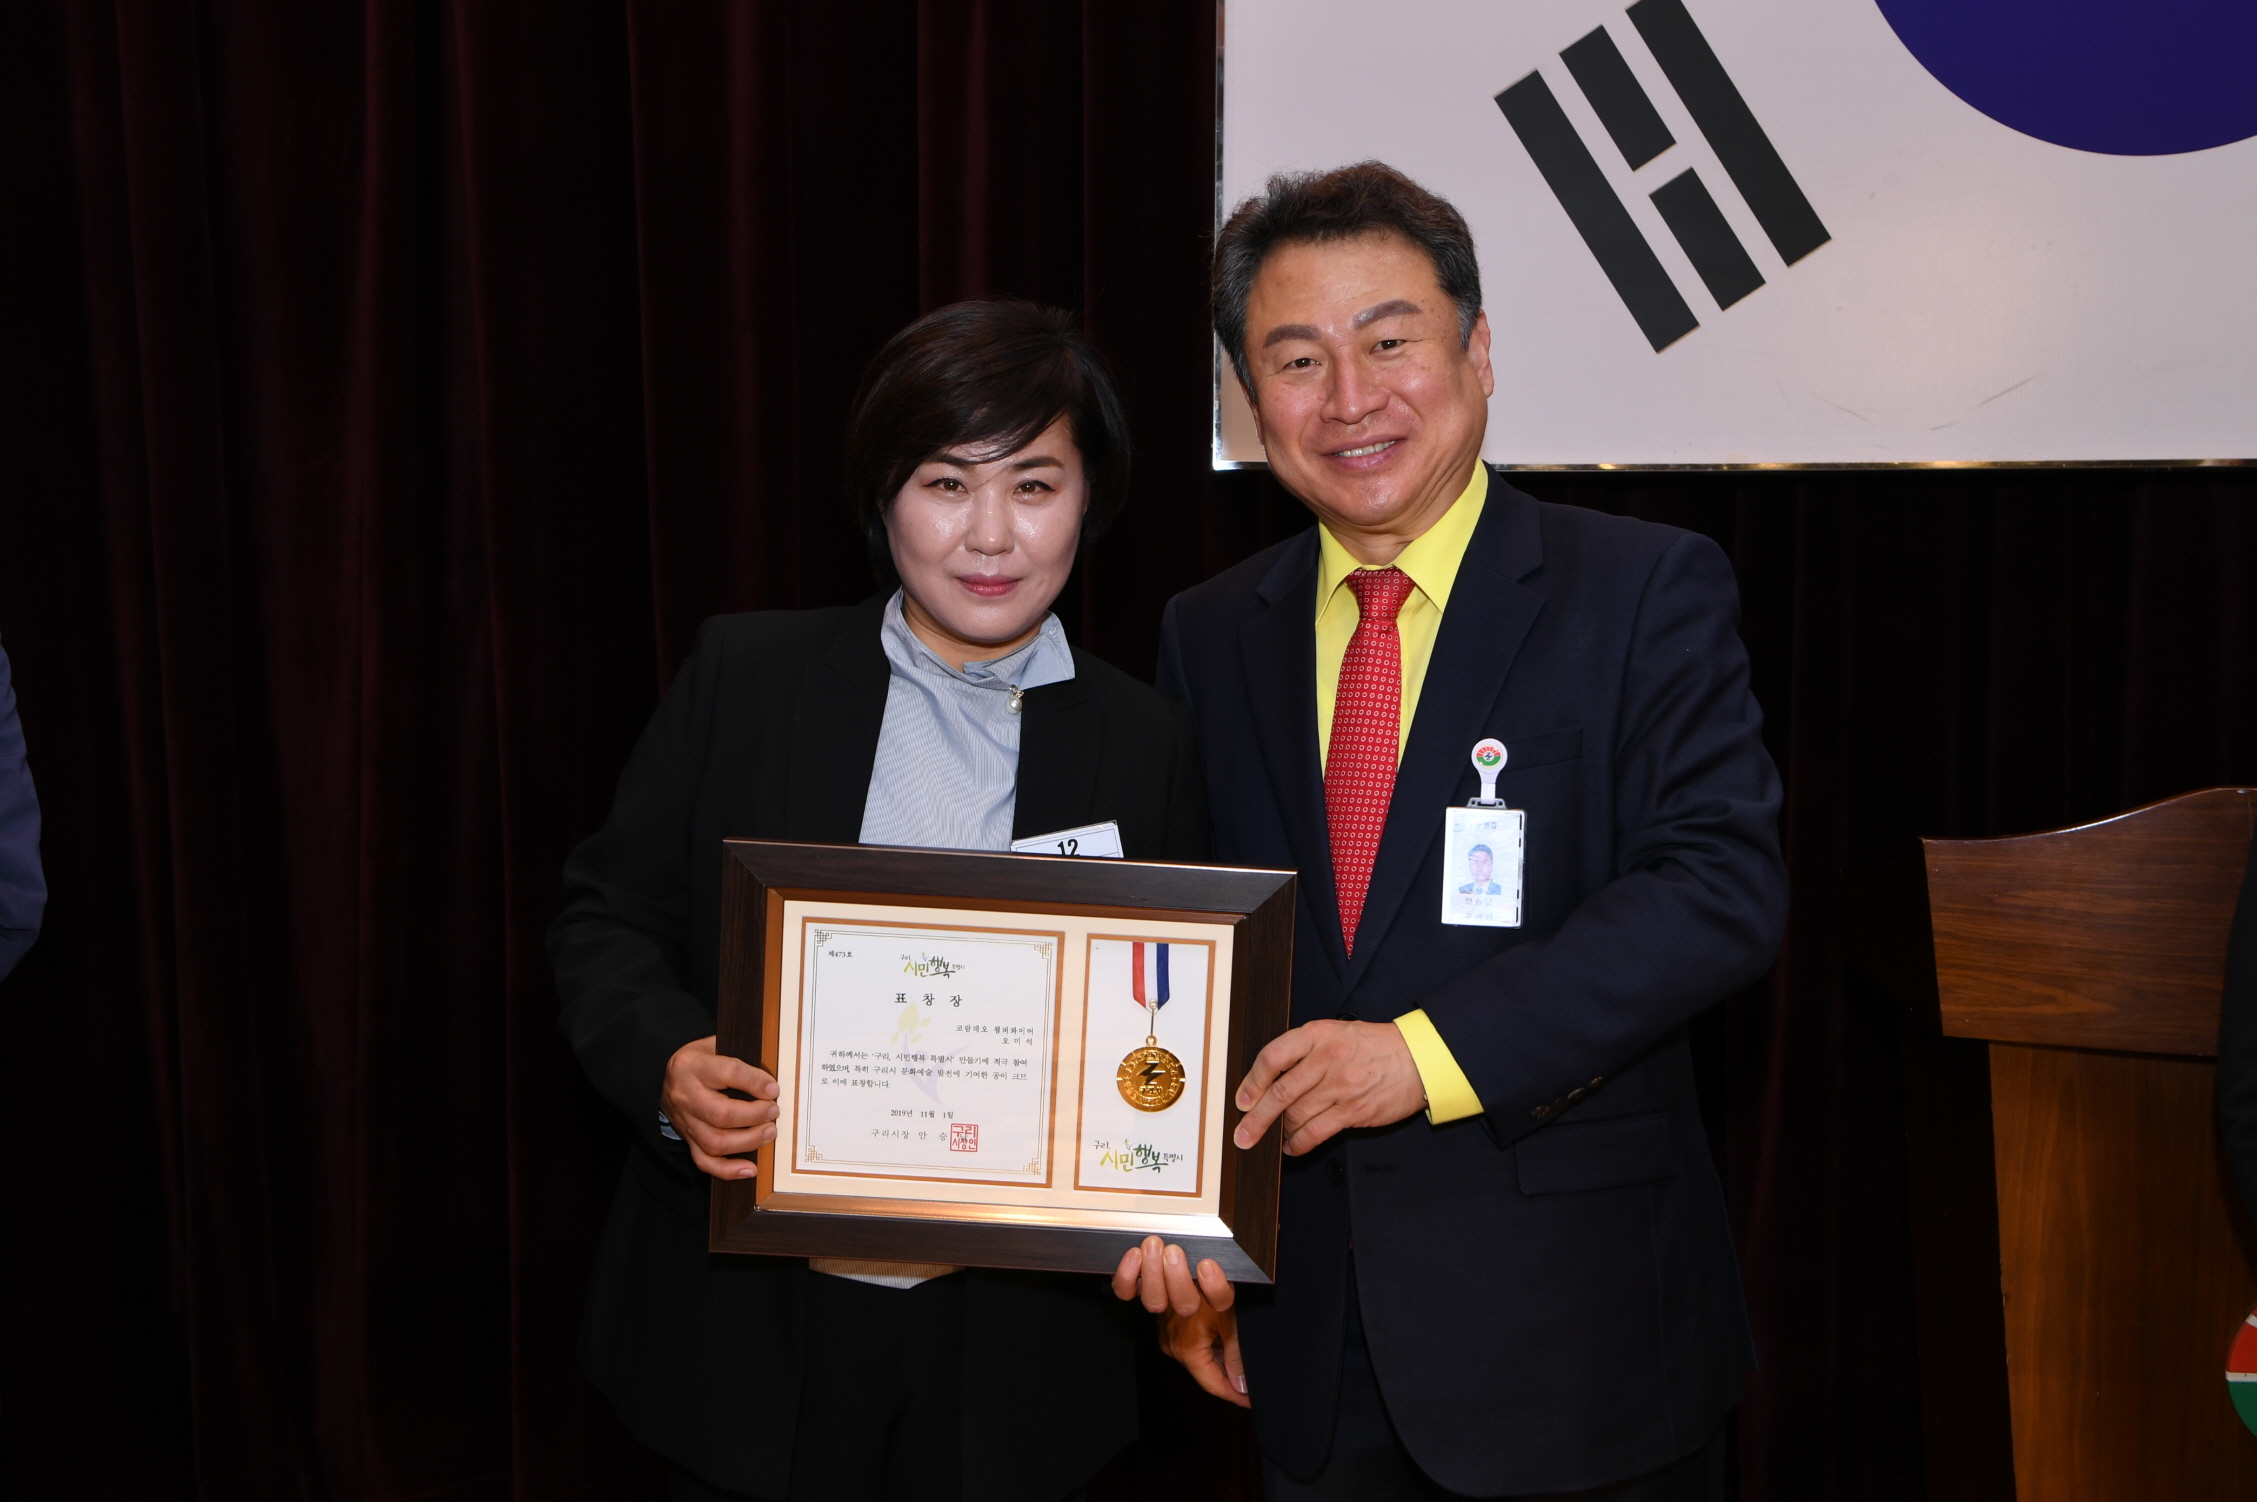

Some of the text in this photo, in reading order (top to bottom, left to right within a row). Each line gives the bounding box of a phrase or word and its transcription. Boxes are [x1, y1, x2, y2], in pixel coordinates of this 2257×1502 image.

[1057, 838, 1080, 855] 12
[827, 949, 853, 958] 제473호
[903, 955, 956, 979] 시민행복
[829, 1050, 869, 1060] 귀하께서는
[895, 1053, 926, 1062] 시민행복
[958, 1055, 989, 1065] 만들기에
[993, 1057, 1009, 1066] 적극
[1012, 1058, 1028, 1067] 참여
[854, 1065, 869, 1073] 특히
[872, 1066, 897, 1075] 구리시
[901, 1067, 933, 1077] 문화예술
[937, 1069, 961, 1078] 발전에
[964, 1070, 988, 1079] 기여한
[992, 1071, 1008, 1080] 공이
[832, 1078, 847, 1086] 이에
[850, 1079, 891, 1088] 표창합니다.
[890, 1109, 954, 1119] 2019년 11월 1일
[871, 1128, 910, 1139] 구리시장
[1099, 1143, 1169, 1173] 시민행복
